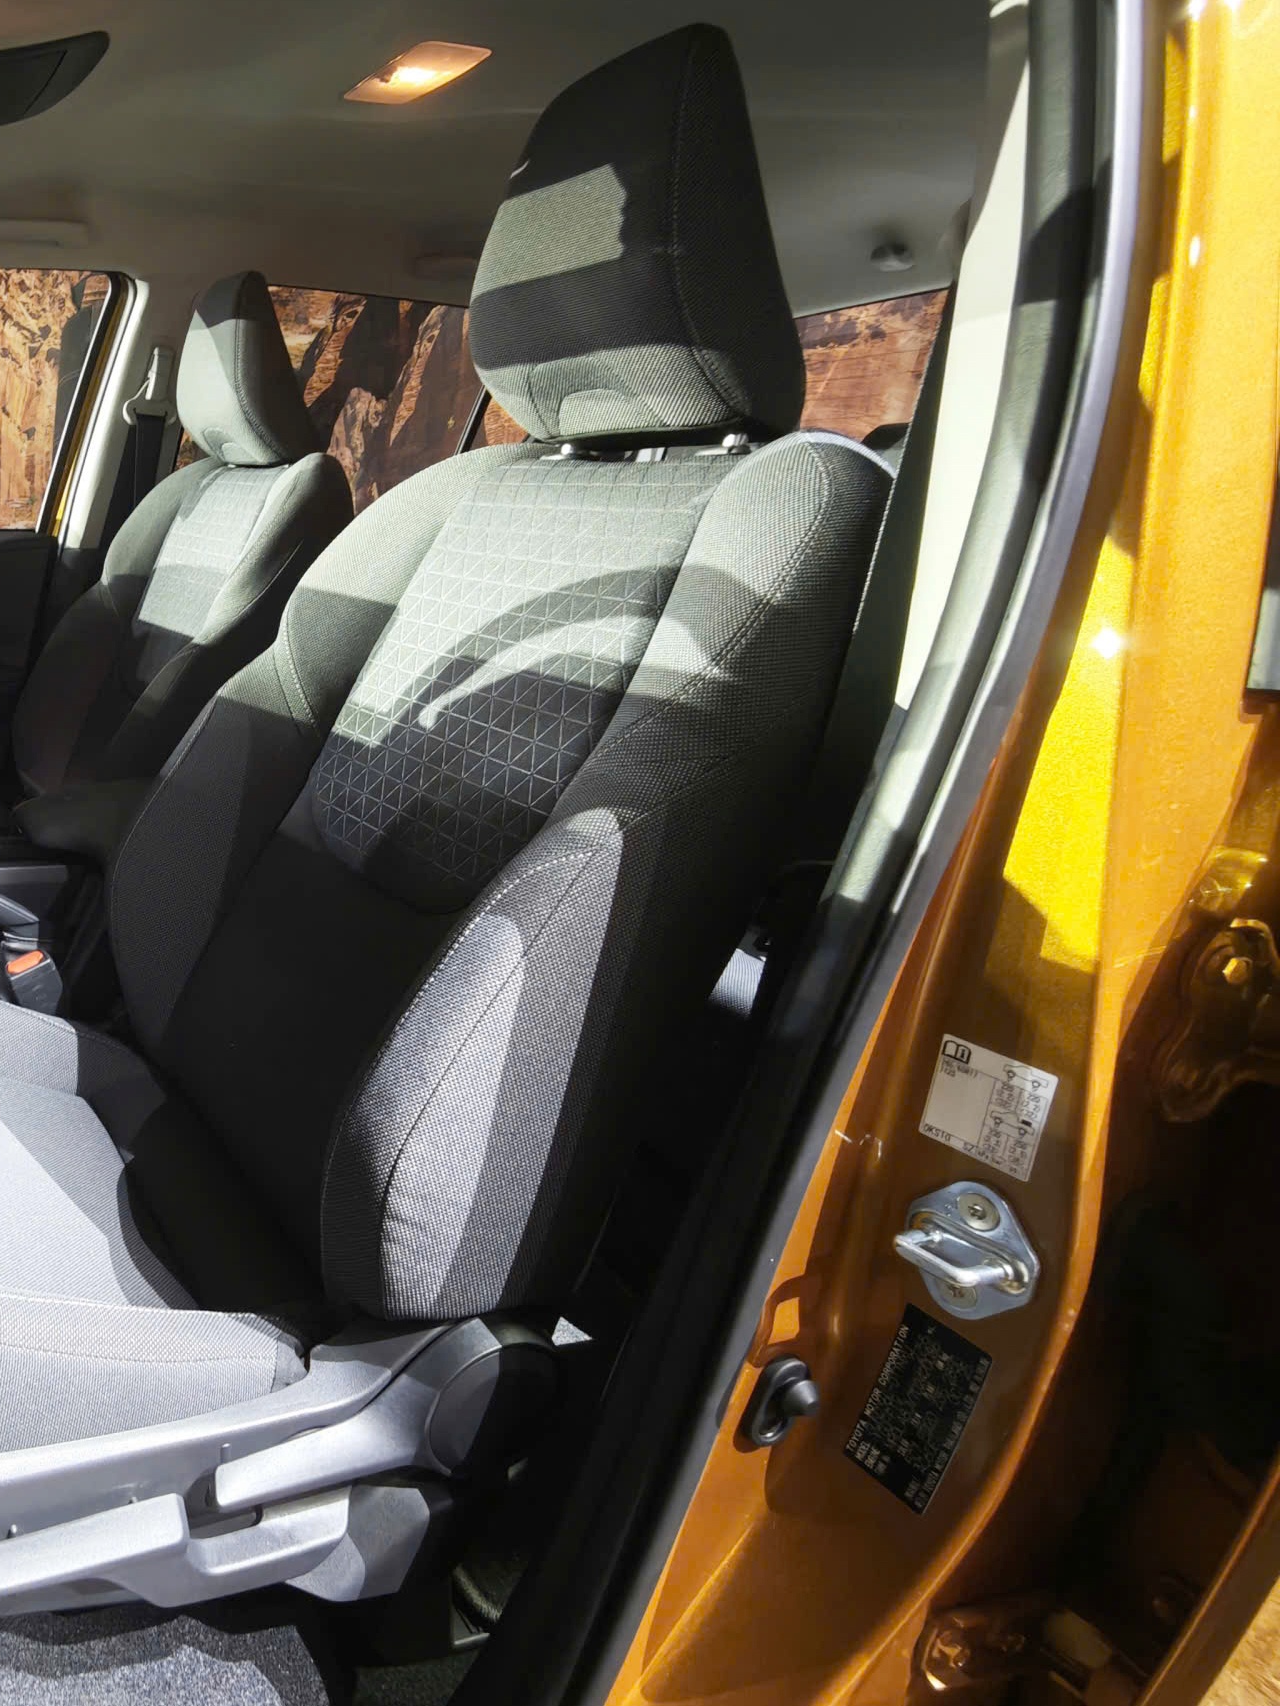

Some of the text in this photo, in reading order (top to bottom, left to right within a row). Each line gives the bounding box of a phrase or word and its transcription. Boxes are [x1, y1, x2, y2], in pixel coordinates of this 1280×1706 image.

[845, 1324, 910, 1452] TOYOTA MOTOR CORPORATION
